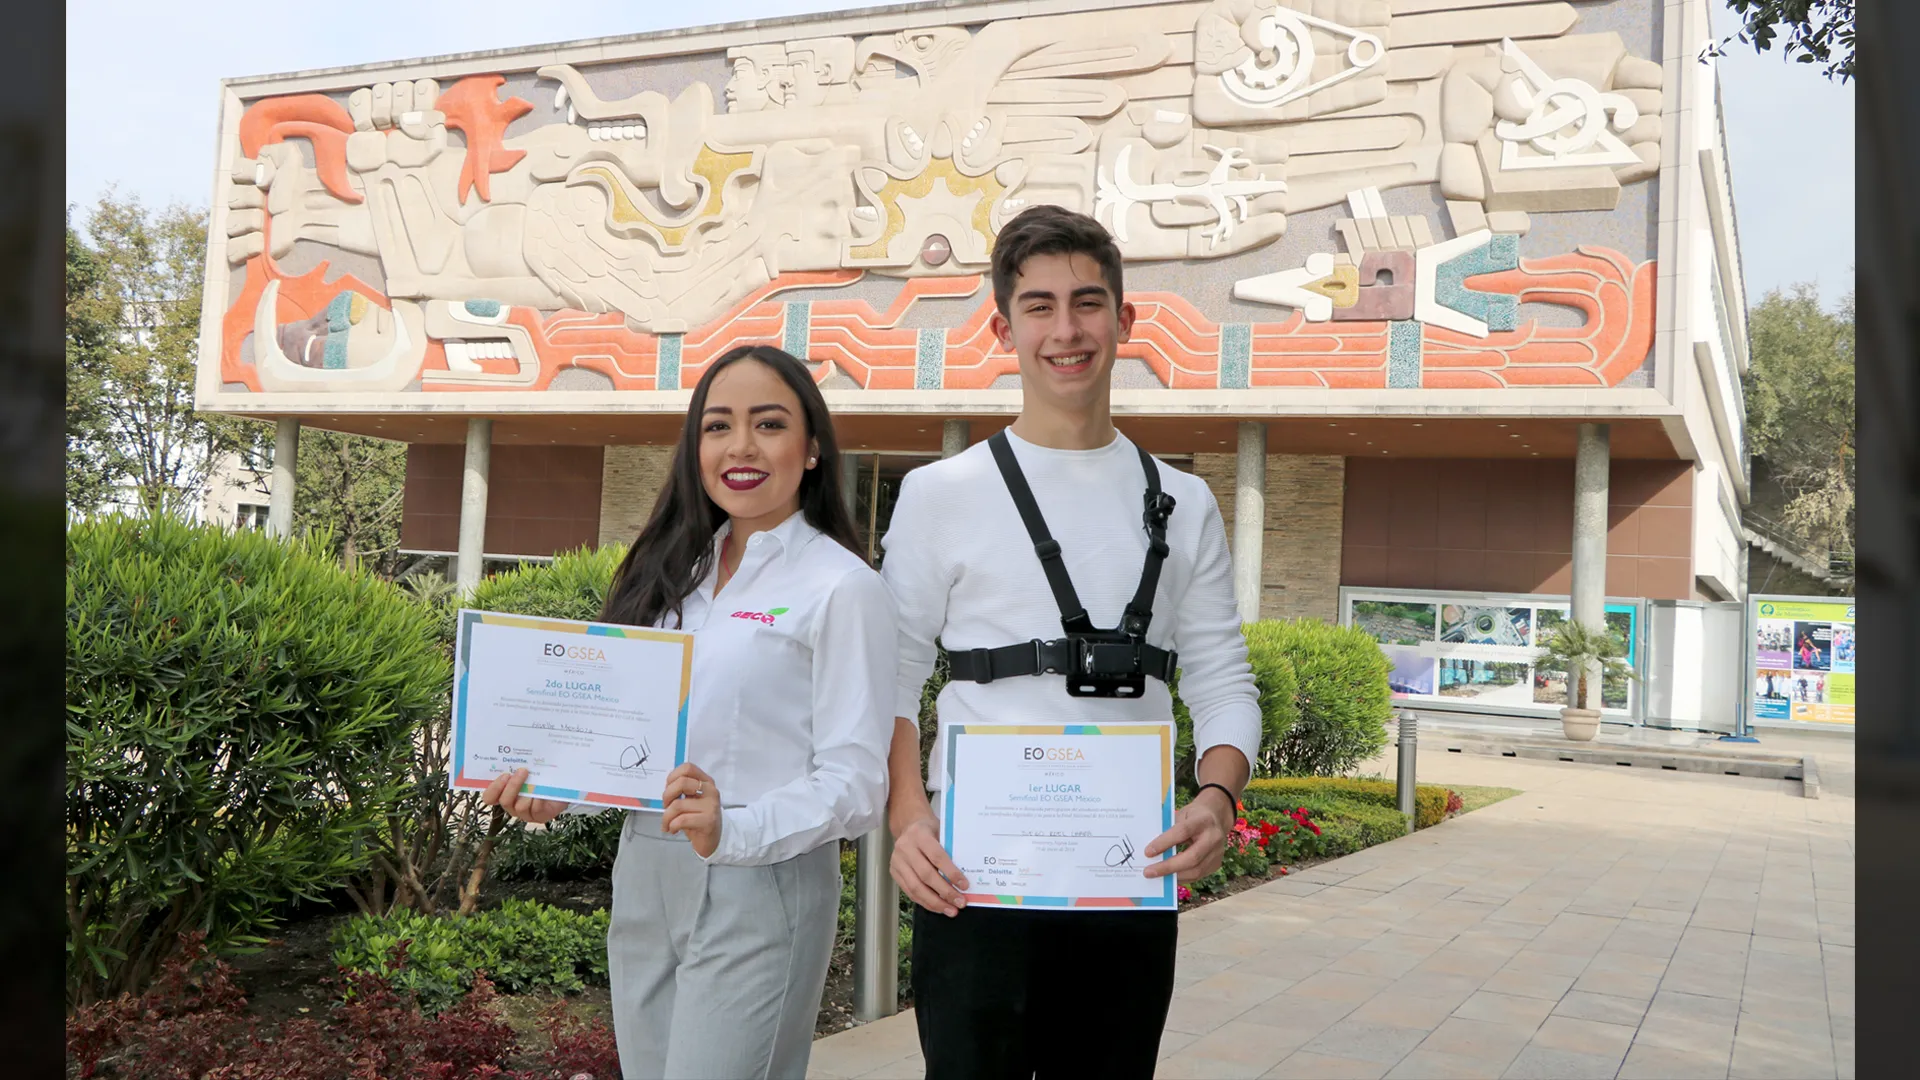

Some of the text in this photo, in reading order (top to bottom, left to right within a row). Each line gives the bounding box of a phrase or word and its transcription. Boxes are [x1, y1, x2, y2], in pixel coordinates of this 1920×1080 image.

[544, 643, 606, 662] EO GSEA
[545, 679, 602, 692] 2do LUGAR
[526, 687, 557, 698] Semifinal
[558, 690, 569, 699] EO
[498, 745, 511, 754] EO
[1024, 747, 1085, 761] EO GSEA
[1028, 784, 1081, 793] 1er LUGAR
[1009, 793, 1038, 802] Semifinal
[1040, 794, 1052, 802] EO
[1053, 794, 1073, 802] GSEA
[984, 856, 997, 865] EO
